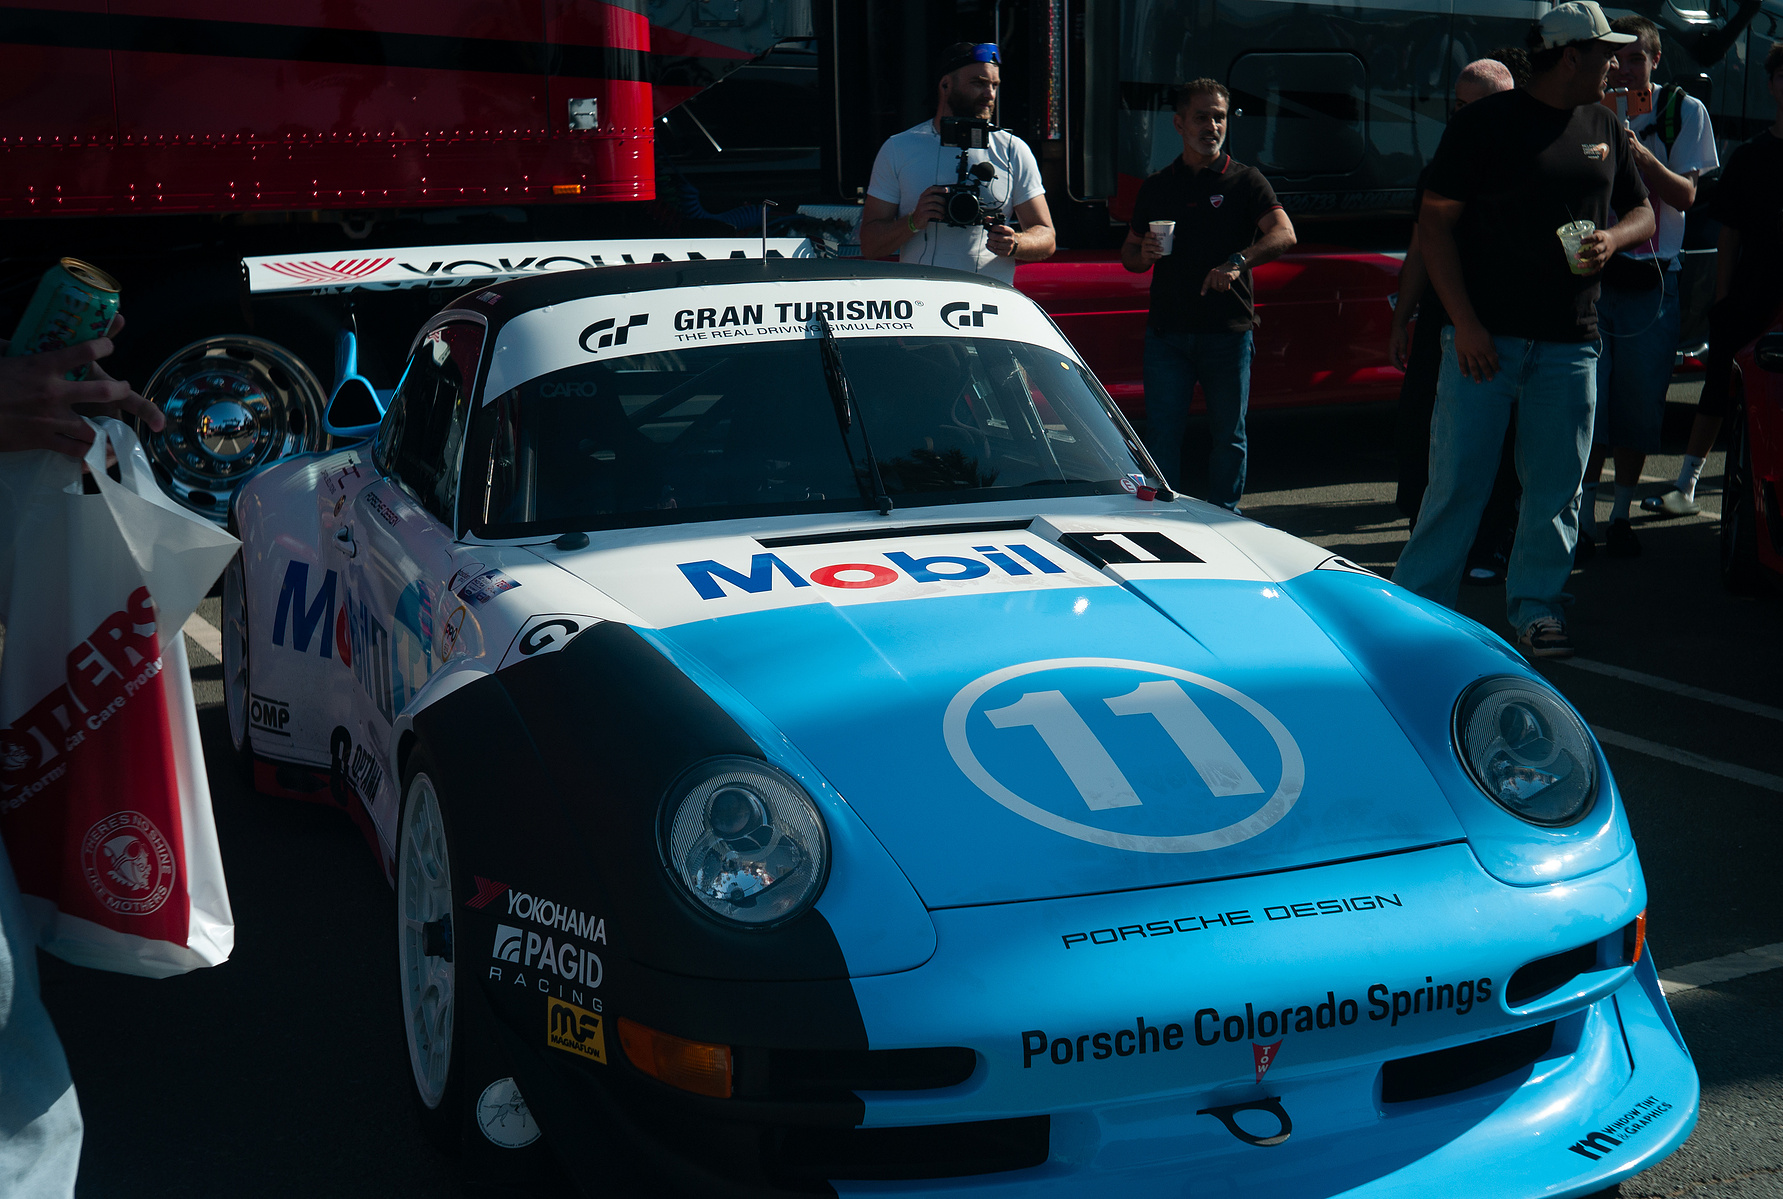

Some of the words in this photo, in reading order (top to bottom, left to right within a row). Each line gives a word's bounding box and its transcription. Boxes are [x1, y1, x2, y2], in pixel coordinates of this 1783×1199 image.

[674, 306, 763, 331] GRAN
[675, 333, 709, 341] THE
[712, 331, 754, 340] REAL
[677, 544, 1066, 600] Mobil
[1092, 533, 1161, 561] 1
[519, 618, 580, 656] G
[85, 695, 127, 731] Care
[251, 700, 290, 729] OMP
[983, 678, 1267, 813] 11
[132, 815, 149, 831] NO
[149, 830, 172, 875] SHINE
[106, 885, 168, 912] MOTHERS
[507, 888, 607, 946] YOKOHAMA
[1061, 909, 1255, 950] PORSCHE
[1263, 892, 1404, 922] DESIGN
[524, 931, 604, 989] PAGID
[489, 966, 604, 1013] RACING
[1021, 1016, 1184, 1069] Porsche
[1193, 991, 1359, 1047] Colorado
[1367, 975, 1493, 1027] Springs
[551, 1033, 600, 1059] MAGNAFLOW
[1257, 1046, 1271, 1073] TOW
